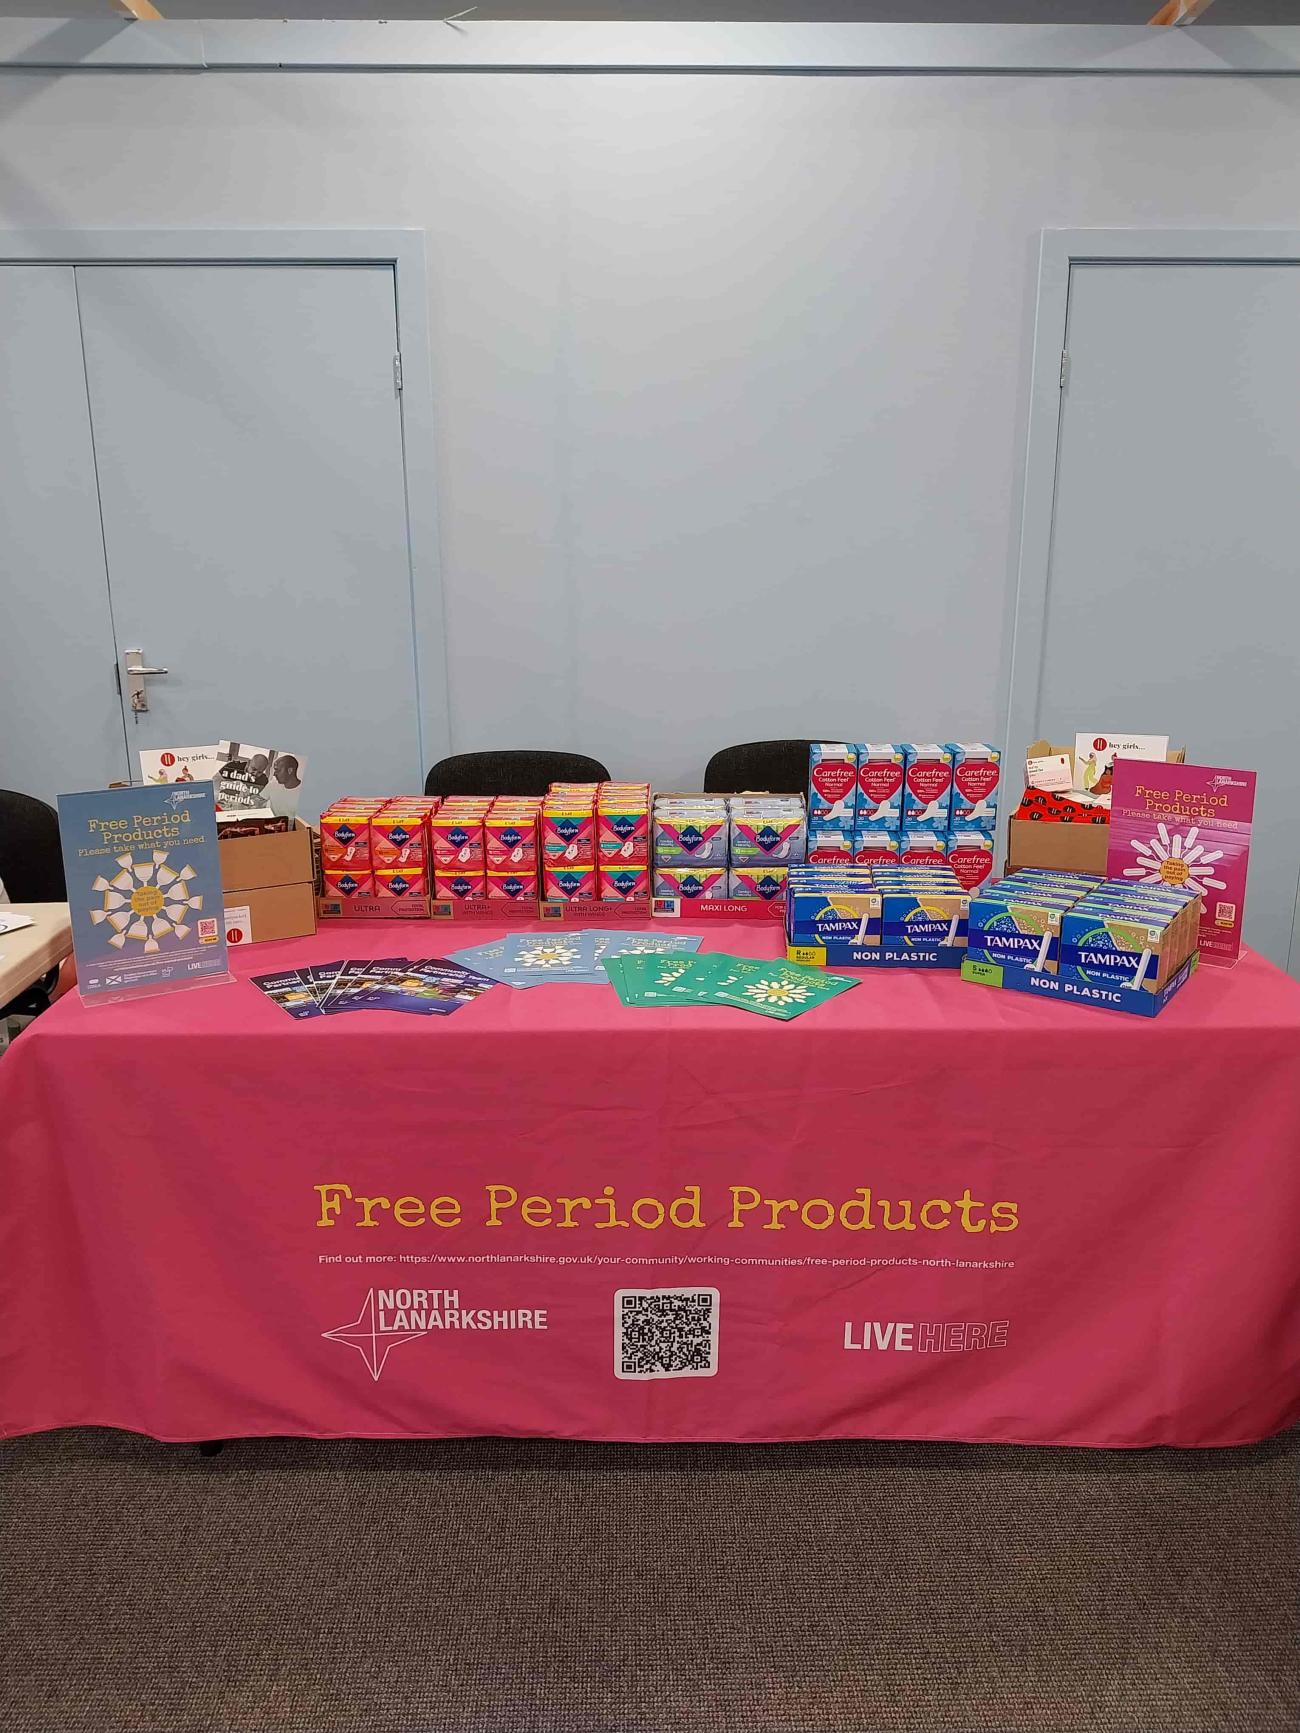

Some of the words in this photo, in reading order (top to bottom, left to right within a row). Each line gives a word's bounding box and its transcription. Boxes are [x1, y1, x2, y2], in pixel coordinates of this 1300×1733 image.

[230, 771, 256, 783] dad's
[814, 768, 854, 777] Carefree
[860, 768, 901, 777] Carefree
[908, 768, 950, 777] Carefree
[956, 768, 998, 777] Carefree
[220, 781, 248, 792] guide
[249, 786, 259, 794] to
[217, 792, 255, 806] periods
[1135, 785, 1169, 800] Free
[1174, 790, 1228, 807] Period
[1145, 798, 1216, 818] Products
[88, 819, 129, 833] Free
[132, 810, 192, 828] Period
[1122, 809, 1151, 819] Please
[1152, 812, 1172, 822] take
[1175, 815, 1196, 825] what
[1198, 819, 1214, 828] you
[1216, 820, 1238, 829] need
[557, 827, 579, 836] Bodyform
[612, 825, 635, 834] Bodyform
[103, 826, 180, 845] Products
[335, 831, 356, 839] Bodyform
[389, 833, 410, 842] Bodyform
[447, 833, 469, 843] Bodyform
[500, 833, 522, 842] Bodyform
[678, 835, 703, 844] Bodyform
[756, 836, 781, 844] Bodyform
[78, 847, 111, 857] Please
[114, 843, 135, 853] take
[138, 840, 161, 851] what
[163, 838, 181, 849] you
[183, 835, 205, 845] need
[809, 855, 850, 864] Carefree
[855, 855, 896, 864] Carefree
[901, 855, 943, 864] Carefree
[949, 855, 990, 864] Carefree
[337, 881, 358, 890] Bodyform
[389, 882, 410, 890] Bodyform
[451, 883, 472, 892] Bodyform
[502, 883, 524, 892] Bodyform
[559, 881, 581, 889] Bodyform
[613, 880, 636, 888] Bodyform
[679, 885, 703, 894] Bodyform
[756, 885, 781, 894] Bodyform
[816, 921, 859, 932] TAMPAX
[905, 922, 949, 933] TAMPAX
[984, 935, 1041, 951] TAMPAX
[853, 952, 880, 961] NON
[885, 952, 938, 961] PLASTIC
[992, 952, 1006, 960] NON
[1007, 954, 1033, 964] PLASTIC
[1078, 951, 1139, 969] TAMPAX
[1102, 973, 1130, 982] PLASTIC
[1030, 976, 1059, 991] NON
[1064, 983, 1122, 1003] PLASTIC
[314, 1184, 462, 1228] Free
[485, 1185, 704, 1230] Period
[727, 1186, 1019, 1233] Products
[318, 1254, 342, 1264] Find
[345, 1254, 363, 1264] out
[365, 1254, 397, 1264] more:
[399, 1254, 1015, 1269] https://www.northlanarkshire.gov.uk/your-community/working-communities/free-period-products-north-lanarkshire
[378, 1289, 459, 1309] NORTH
[379, 1309, 548, 1331] LANARKSHIRE
[844, 1321, 914, 1351] LIVE
[918, 1320, 1009, 1353] HERE
